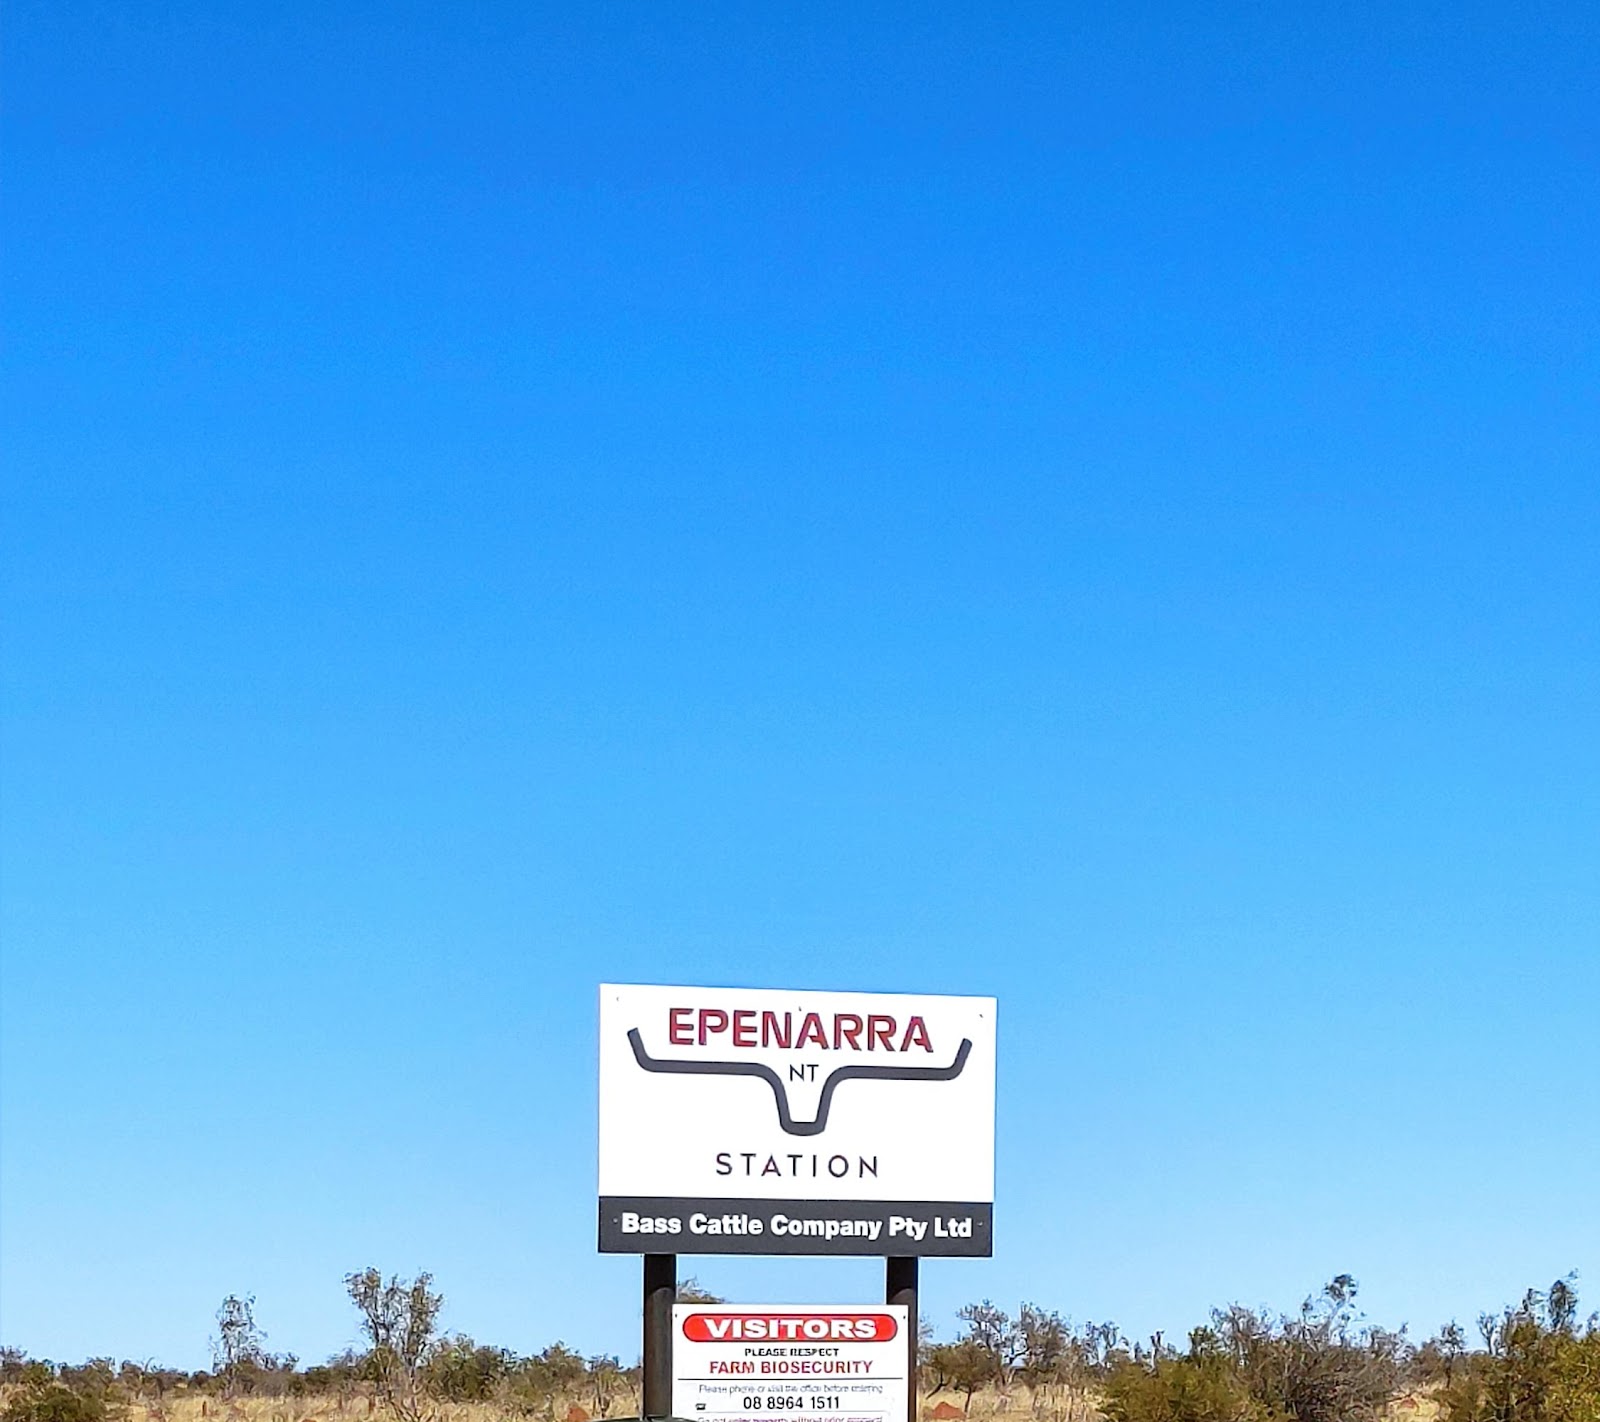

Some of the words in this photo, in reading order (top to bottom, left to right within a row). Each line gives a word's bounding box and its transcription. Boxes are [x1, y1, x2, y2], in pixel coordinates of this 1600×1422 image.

[669, 1007, 934, 1053] EPENARRA
[789, 1064, 819, 1083] NT
[716, 1153, 878, 1178] STATION
[621, 1213, 681, 1233] Bass
[690, 1214, 763, 1235] Cattle
[770, 1215, 882, 1241] Company
[888, 1217, 928, 1241] Pty
[935, 1218, 972, 1237] Ltd
[704, 1318, 877, 1339] VISITORS
[744, 1348, 786, 1357] PLEASE
[790, 1348, 839, 1357] RESPECT
[709, 1361, 755, 1374] FARM
[761, 1360, 873, 1374] BIOSECURITY
[743, 1396, 762, 1409] 08
[767, 1396, 803, 1409] 8964
[811, 1396, 839, 1409] 1511
